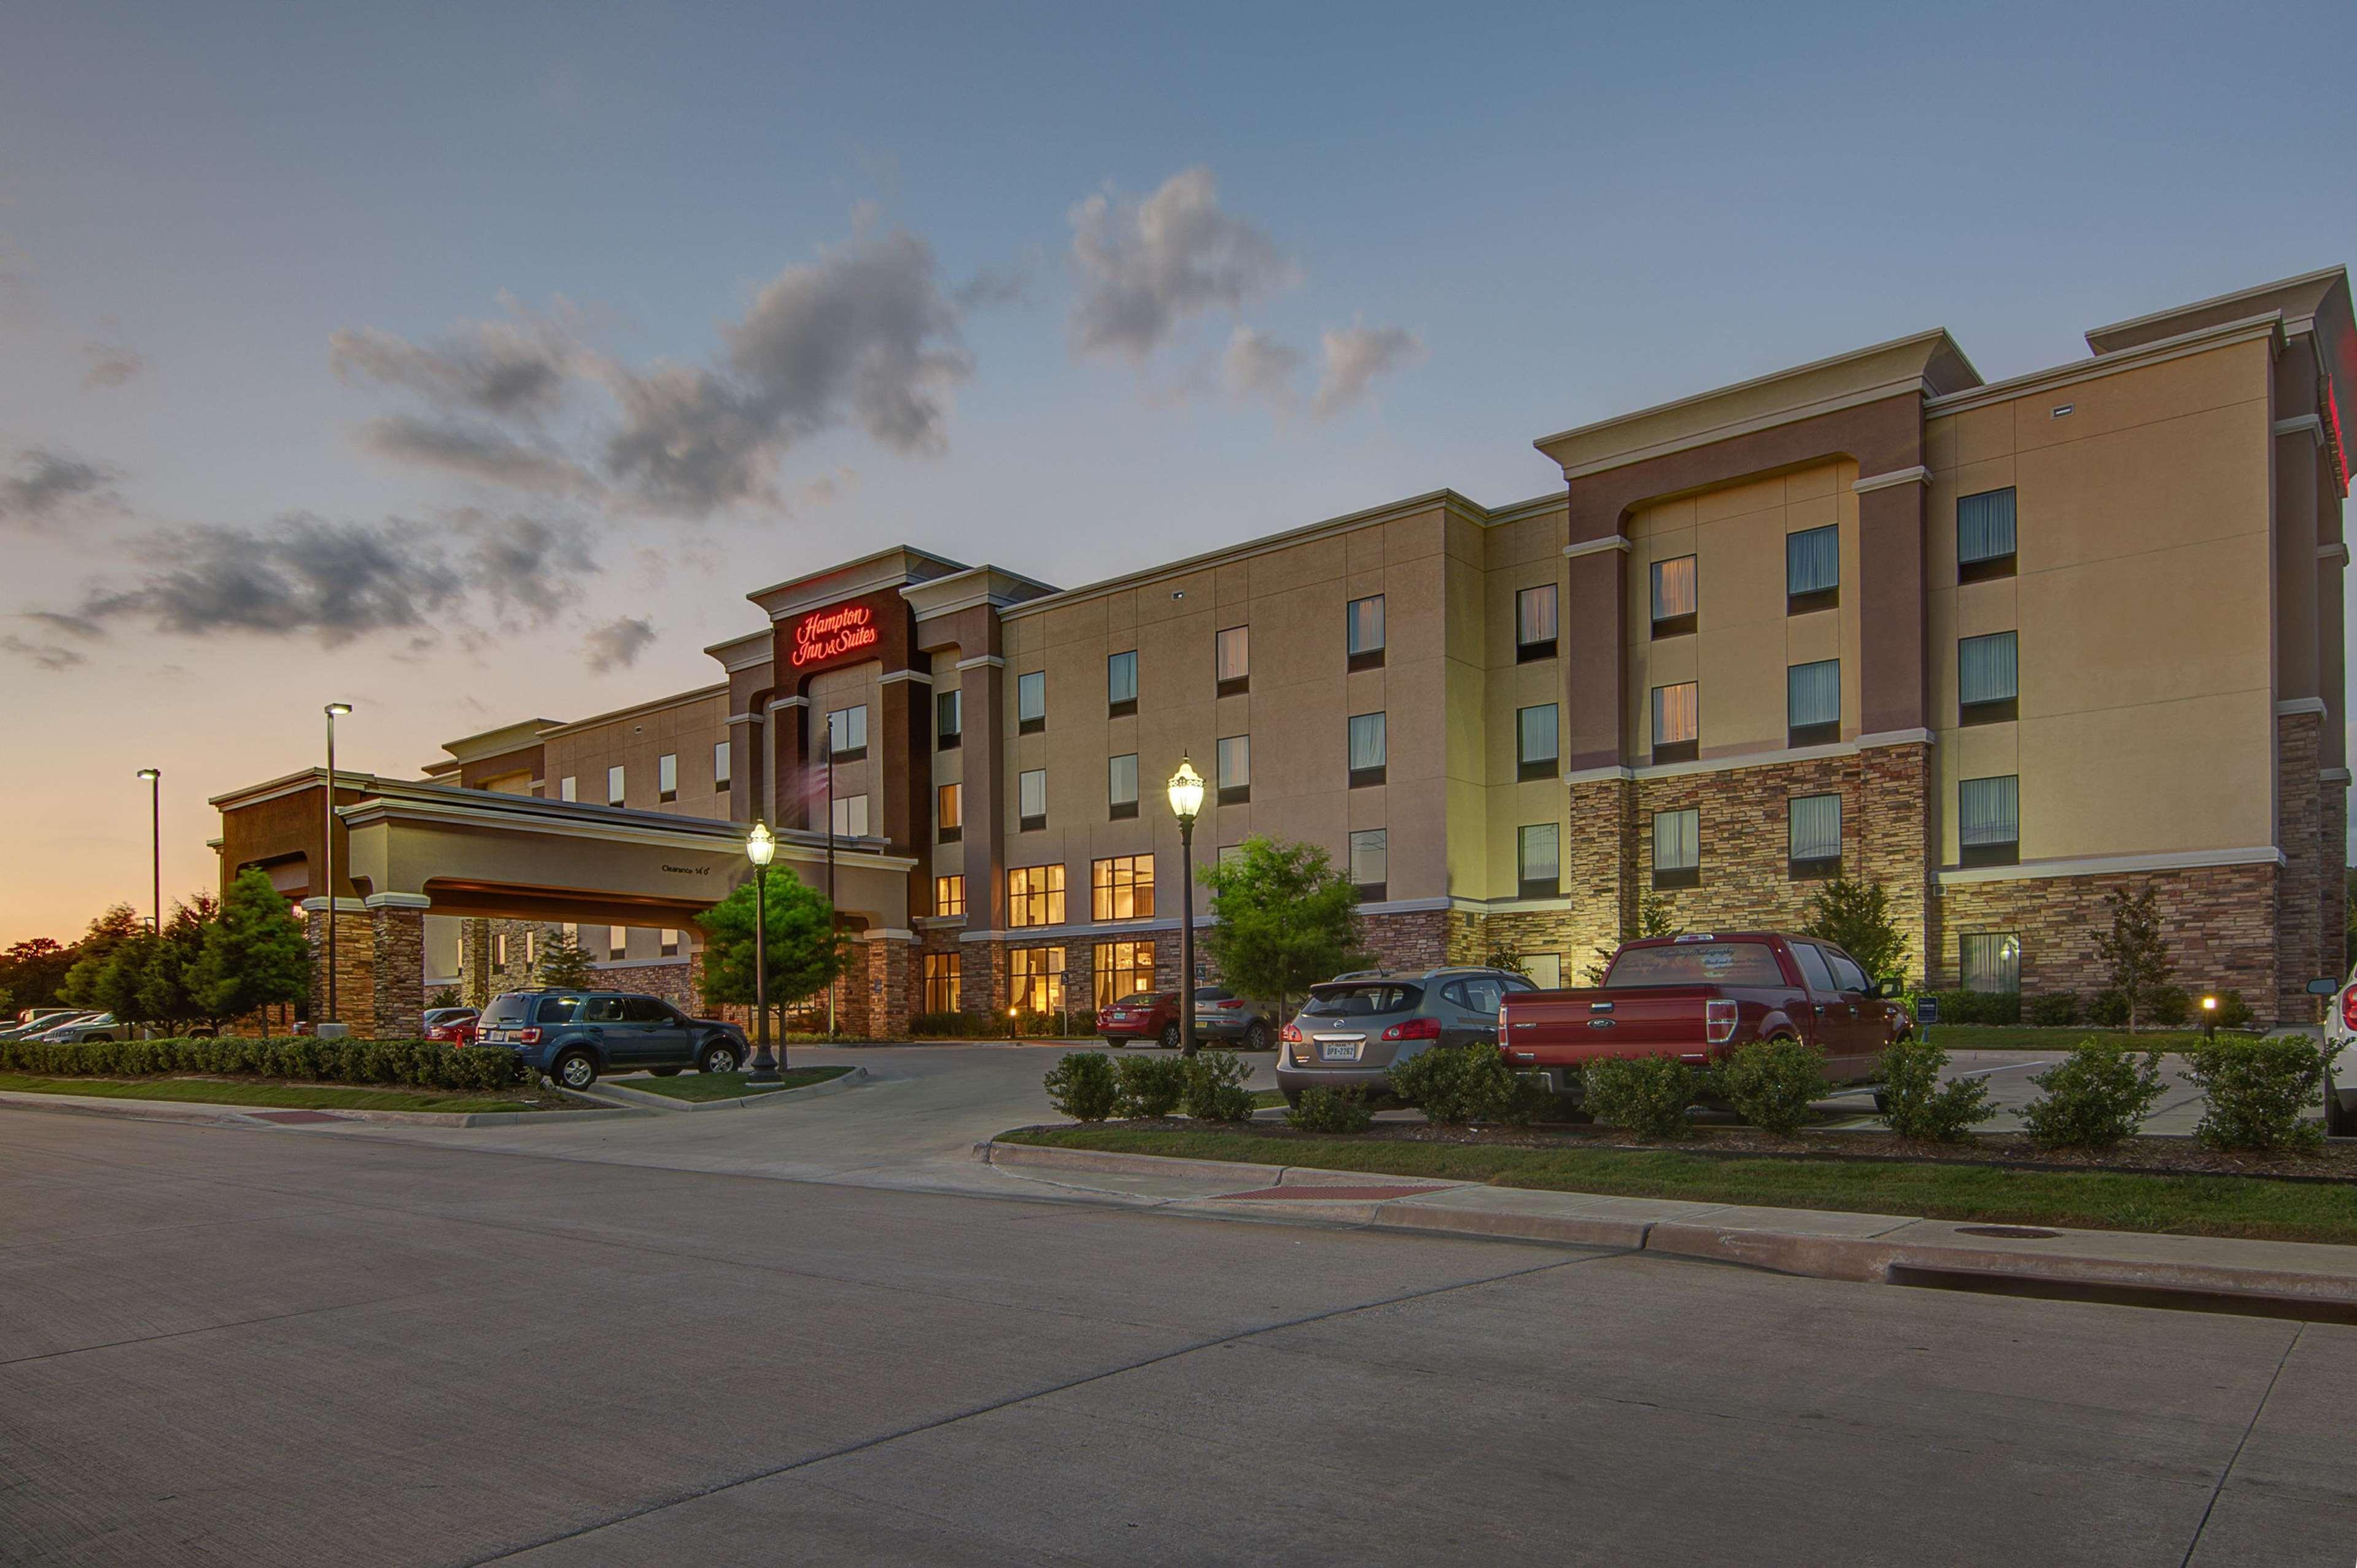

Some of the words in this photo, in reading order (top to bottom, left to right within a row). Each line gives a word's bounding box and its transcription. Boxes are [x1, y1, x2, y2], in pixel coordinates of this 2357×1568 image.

[798, 608, 869, 644] Hampton
[792, 641, 828, 665] Inn
[828, 639, 837, 654] &
[836, 627, 875, 651] Suites
[662, 865, 693, 874] Clearance
